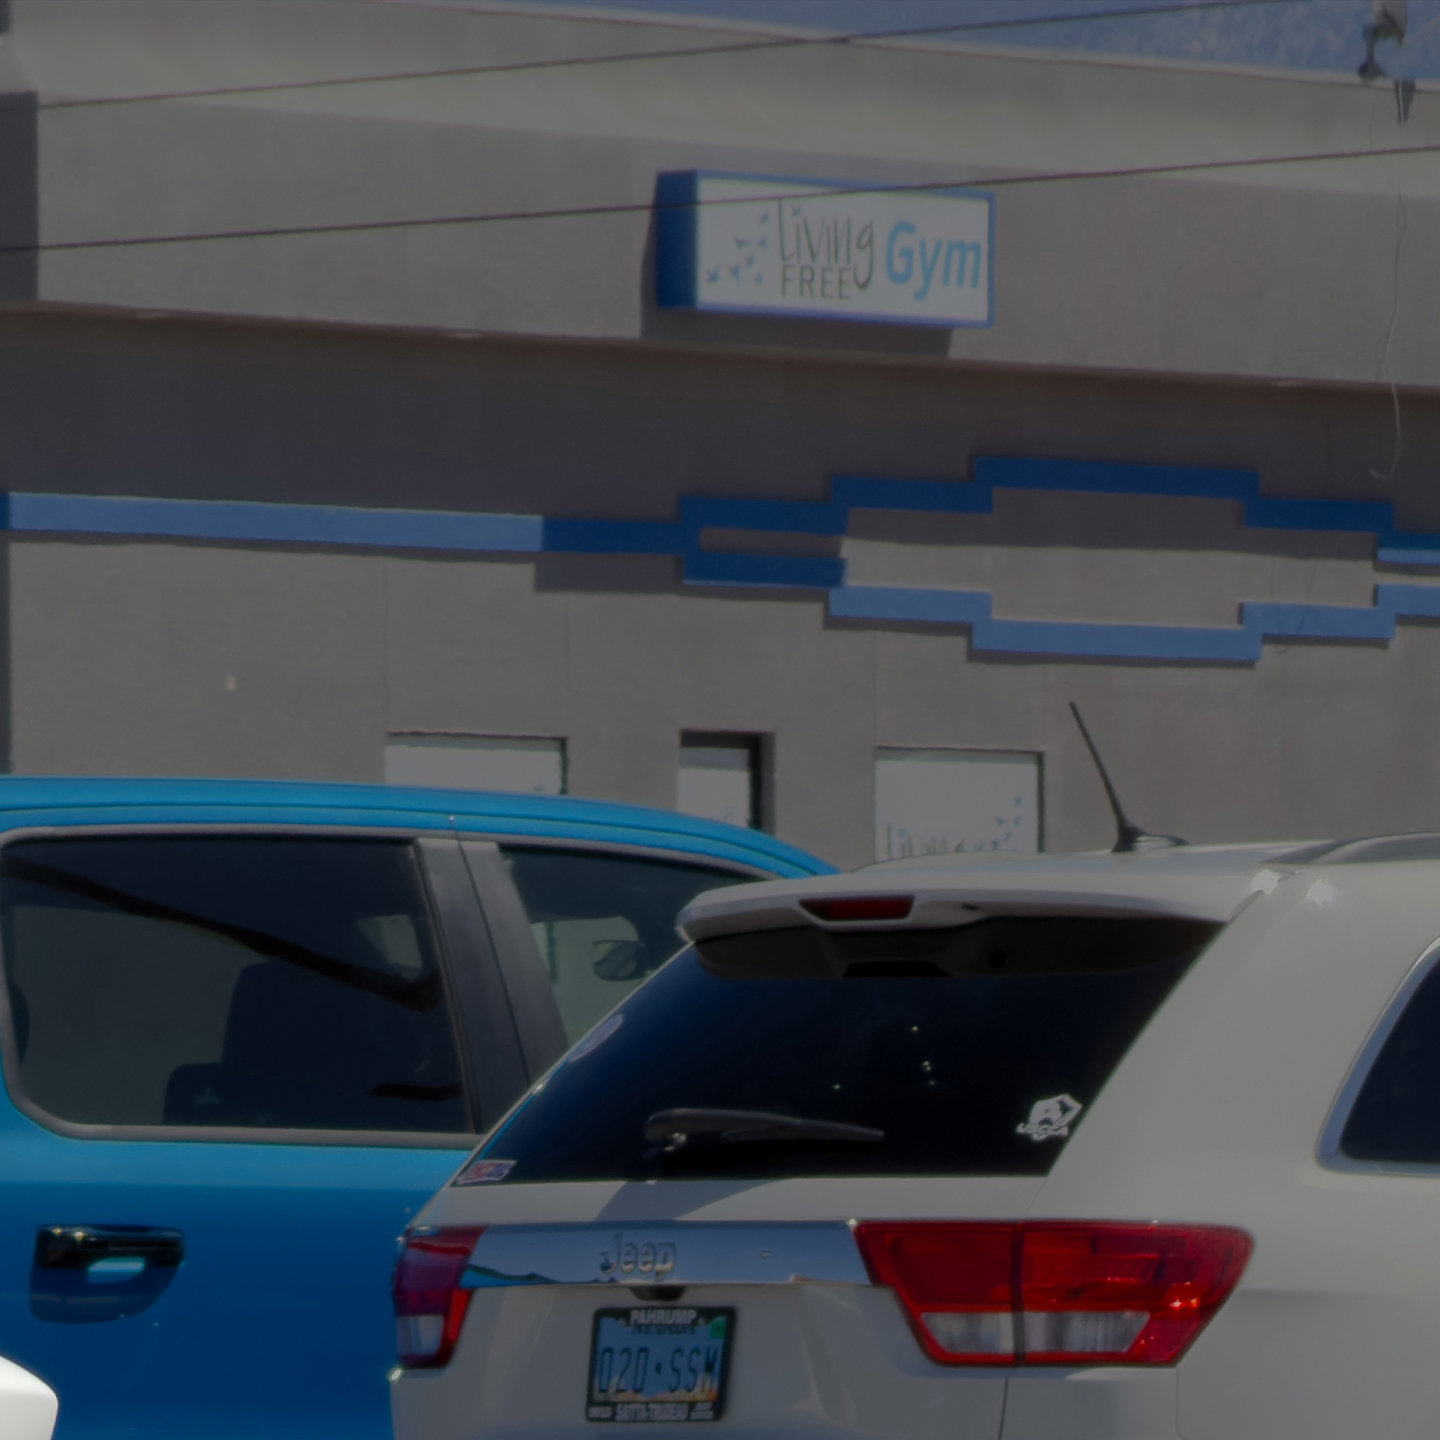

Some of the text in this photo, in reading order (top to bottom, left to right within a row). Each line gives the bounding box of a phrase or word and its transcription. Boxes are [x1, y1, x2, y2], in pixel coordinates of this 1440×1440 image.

[885, 220, 982, 301] Gym
[781, 265, 852, 299] FREE
[600, 1232, 677, 1282] Jeep
[629, 1309, 697, 1325] PAHRUMP
